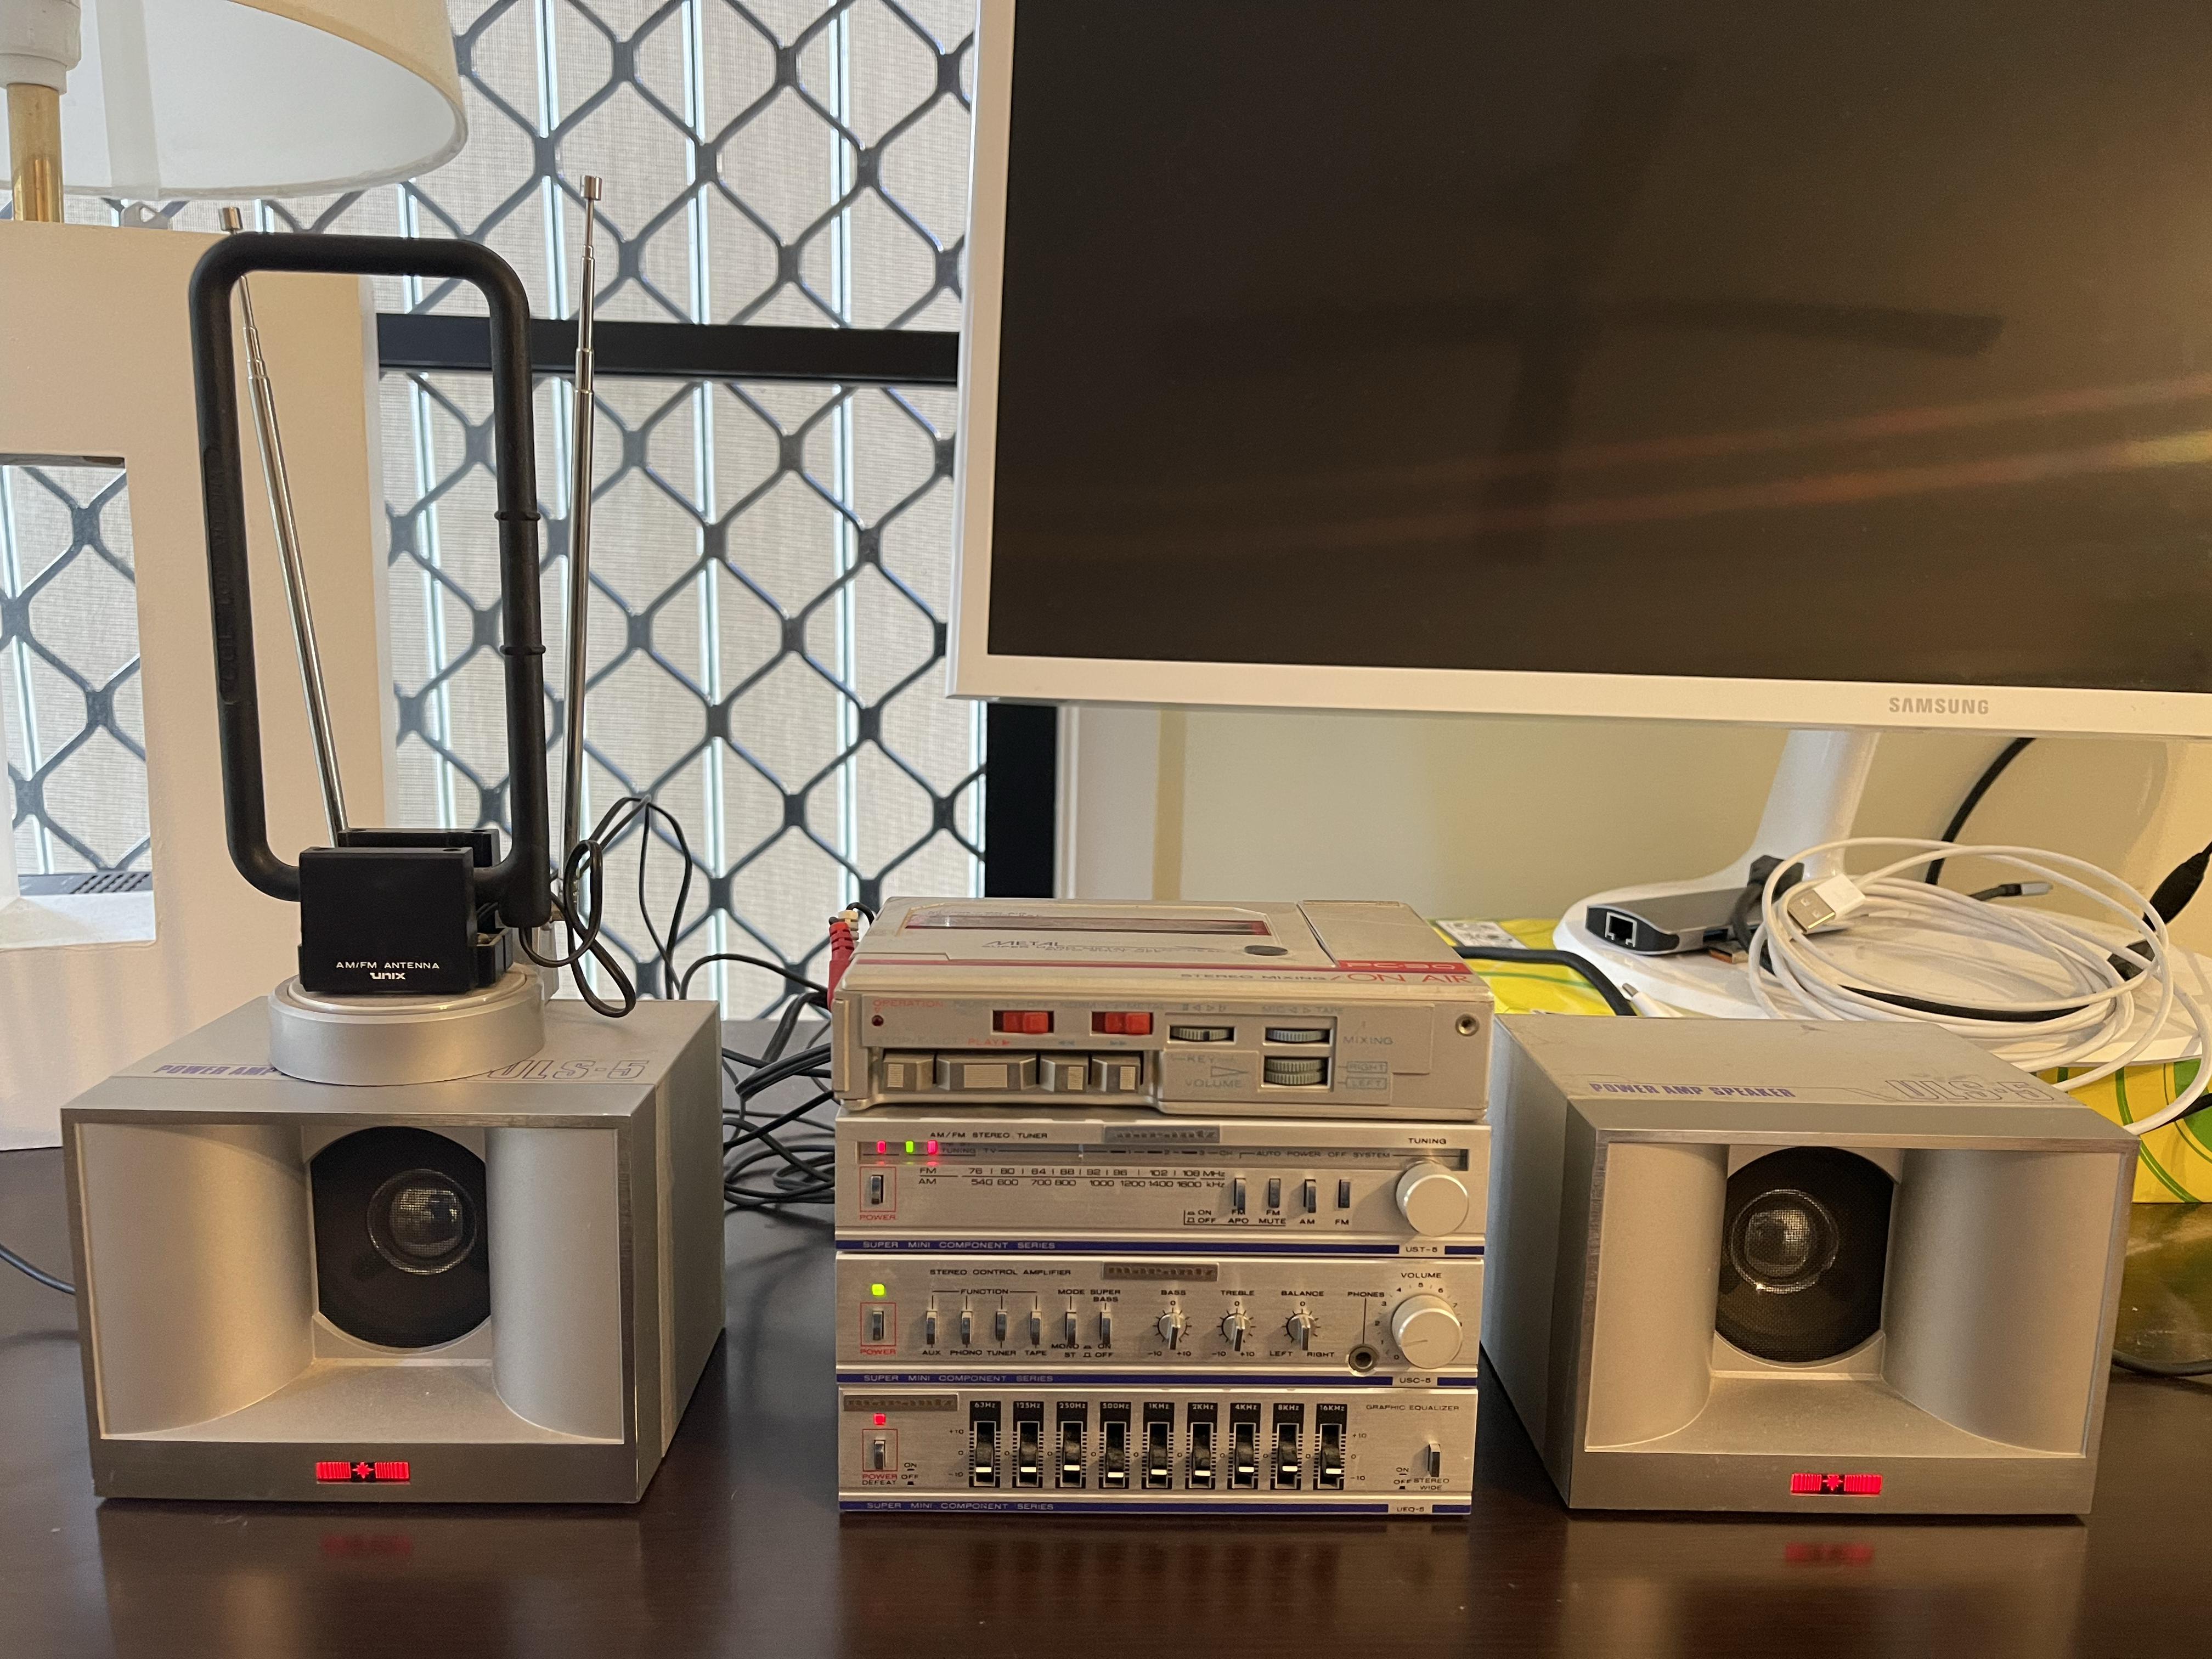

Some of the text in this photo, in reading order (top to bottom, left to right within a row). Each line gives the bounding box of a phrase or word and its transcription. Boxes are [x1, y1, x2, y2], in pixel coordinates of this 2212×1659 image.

[1889, 697, 1989, 714] SAMSUNG
[1421, 974, 1472, 984] AIR
[873, 1000, 943, 1008] OPERATION
[967, 1037, 1000, 1046] PLAY
[1343, 1035, 1394, 1046] MIXING
[1186, 1054, 1214, 1063] KEY
[154, 1065, 231, 1075] POWER
[1347, 1063, 1387, 1073] RIGHT
[1185, 1079, 1243, 1088] VOLUME
[1350, 1079, 1384, 1088] LEFT
[1589, 1083, 1797, 1098] POWER AMP SPEAKER
[1884, 1080, 2055, 1101] ULS-5
